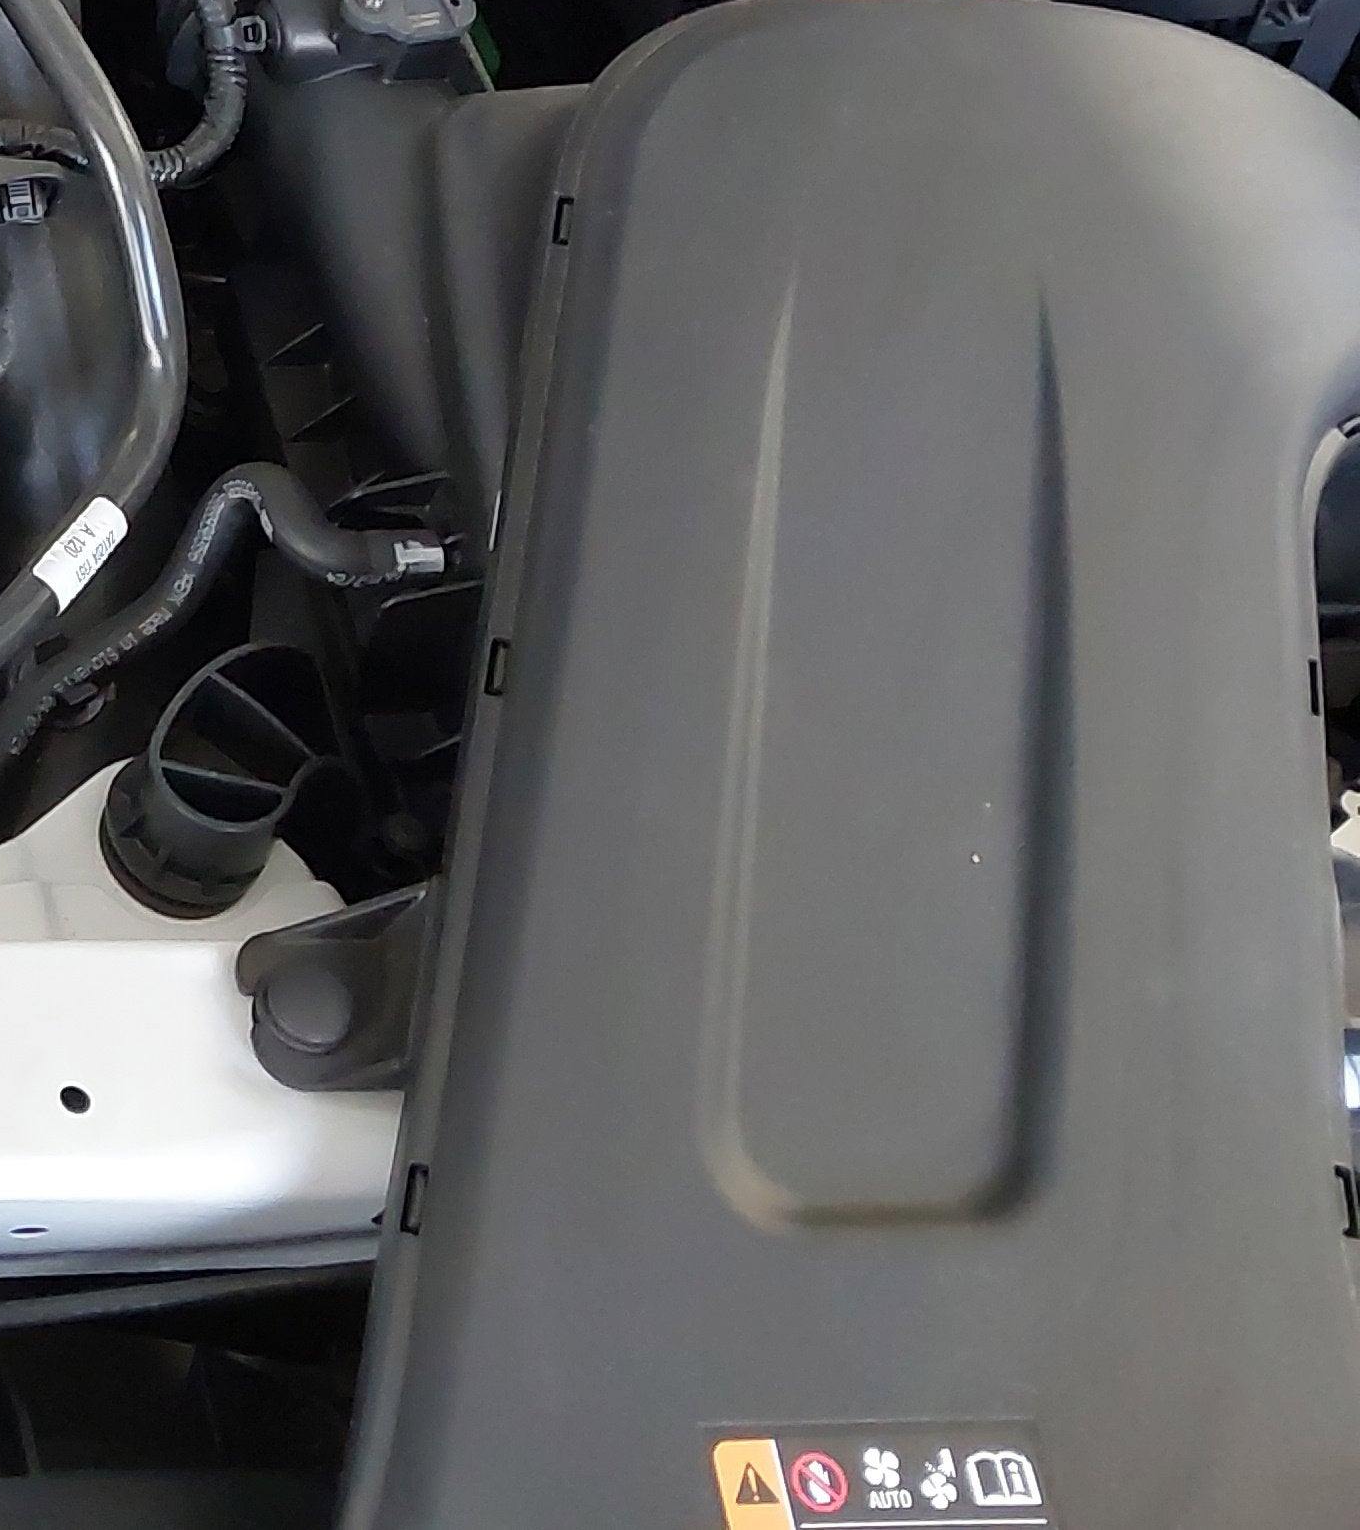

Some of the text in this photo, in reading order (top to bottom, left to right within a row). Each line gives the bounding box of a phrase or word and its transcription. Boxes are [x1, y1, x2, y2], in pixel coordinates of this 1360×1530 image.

[63, 523, 97, 559] A 120
[869, 1489, 914, 1510] AUTO
